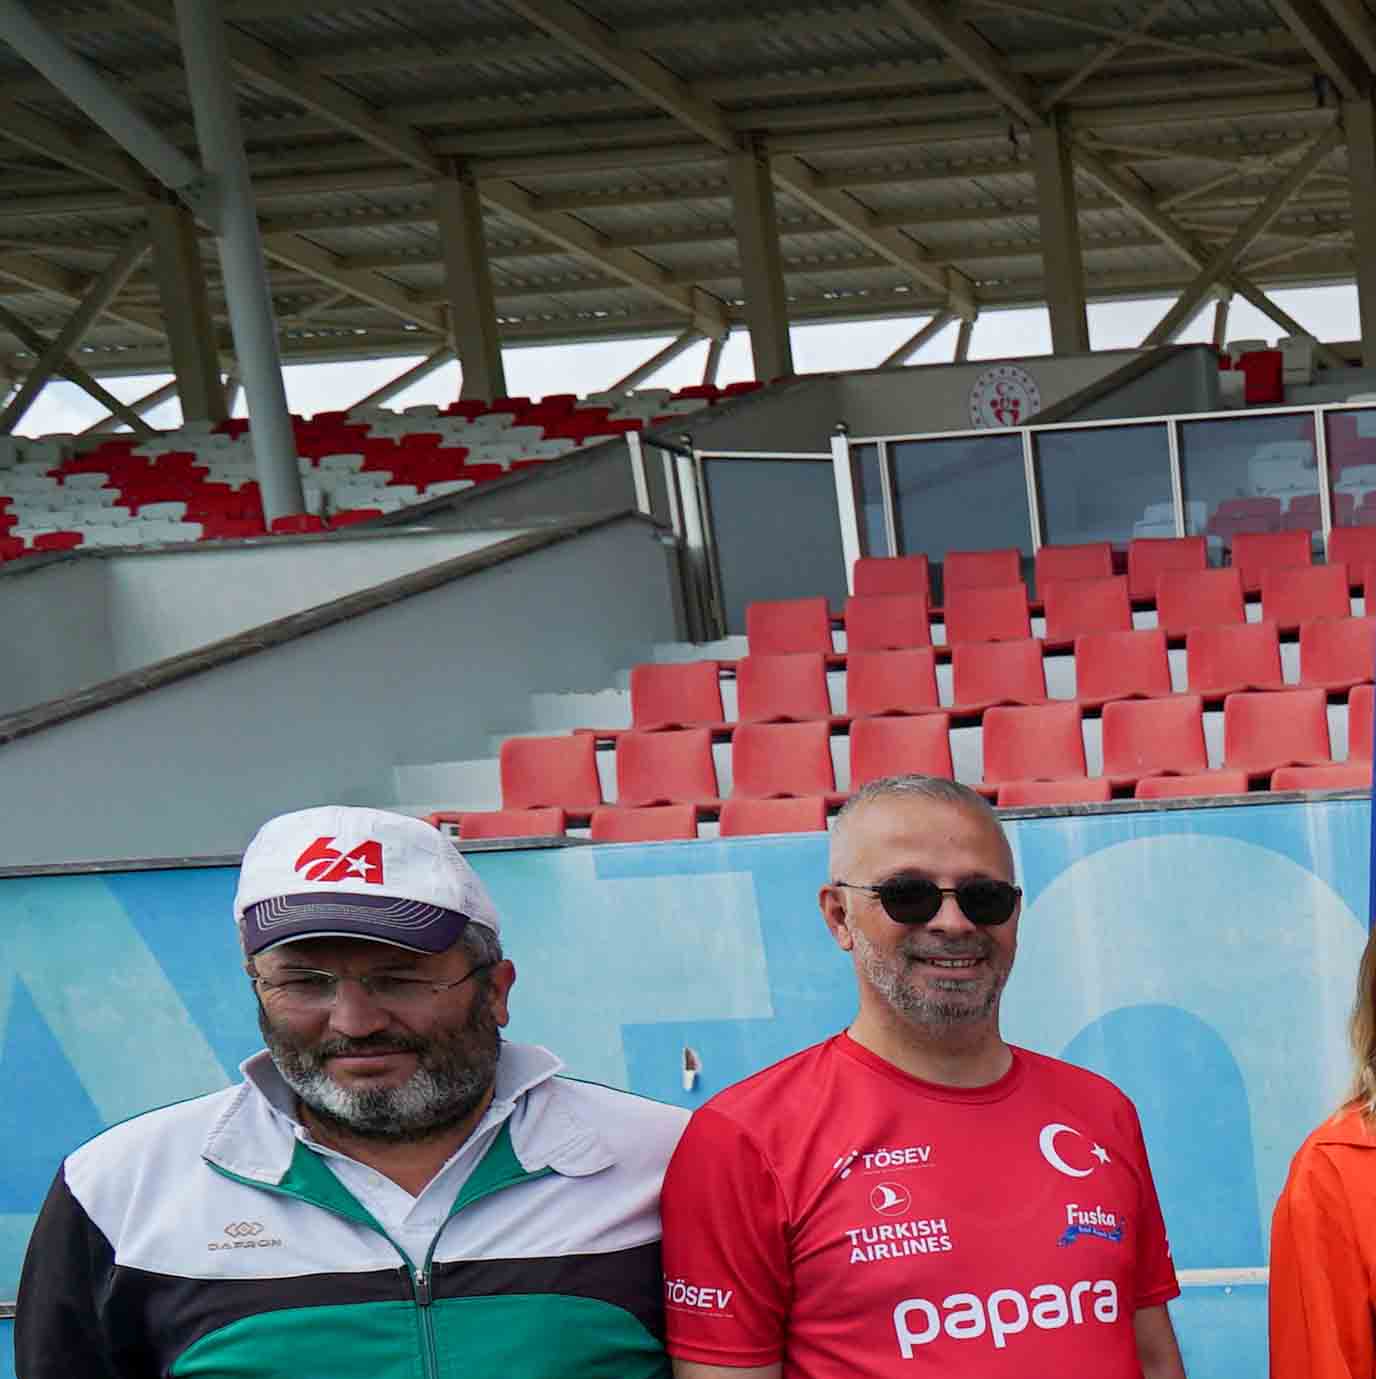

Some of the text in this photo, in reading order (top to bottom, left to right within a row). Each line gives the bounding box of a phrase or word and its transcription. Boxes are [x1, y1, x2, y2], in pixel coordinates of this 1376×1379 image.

[862, 1146, 931, 1169] TÖSEV
[1065, 1203, 1116, 1227] Fuska
[846, 1219, 948, 1245] TURKISH
[850, 1235, 953, 1264] AIRLINES
[666, 1279, 733, 1309] TÖSEV
[893, 1279, 1120, 1360] papara
